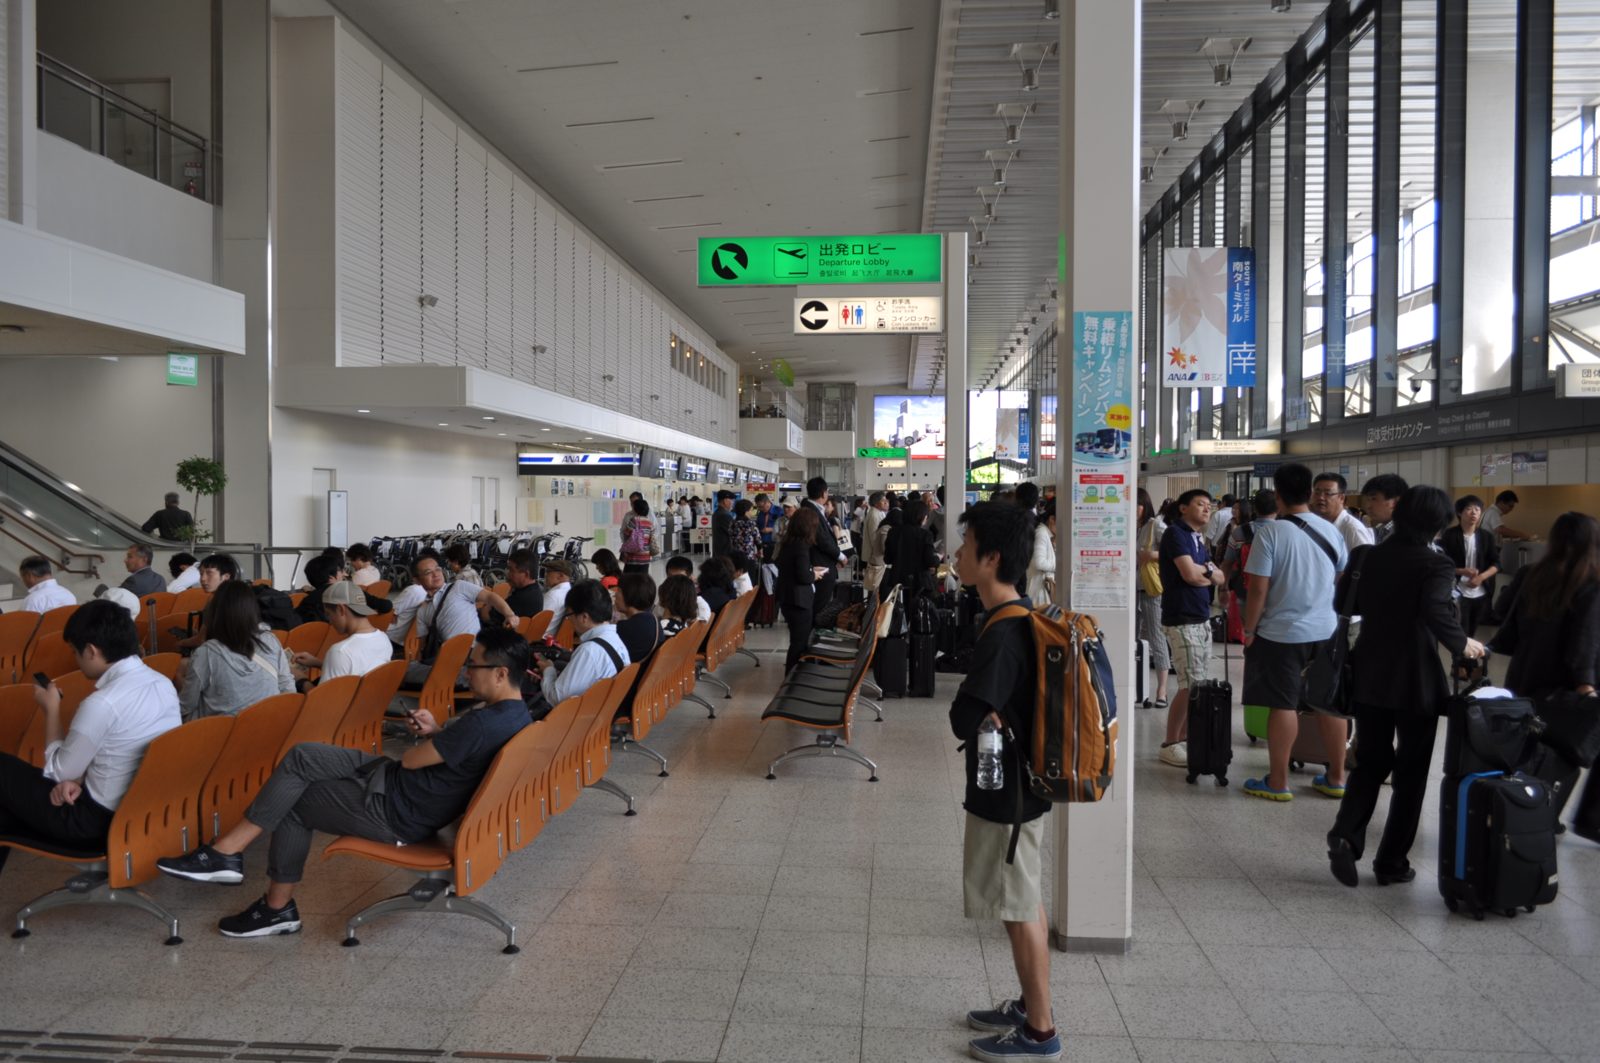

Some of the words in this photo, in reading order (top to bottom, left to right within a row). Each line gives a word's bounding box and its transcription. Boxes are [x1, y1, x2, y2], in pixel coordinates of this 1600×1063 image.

[819, 243, 897, 256] 出発ロビー
[819, 259, 861, 267] Departure
[863, 258, 890, 267] Lobby
[1232, 261, 1244, 323] 南ターミナル
[1077, 316, 1099, 417] 無料キャンペーン
[1167, 373, 1188, 381] ANA
[1367, 422, 1432, 443] 団体受付カウンター
[562, 455, 580, 463] ANA
